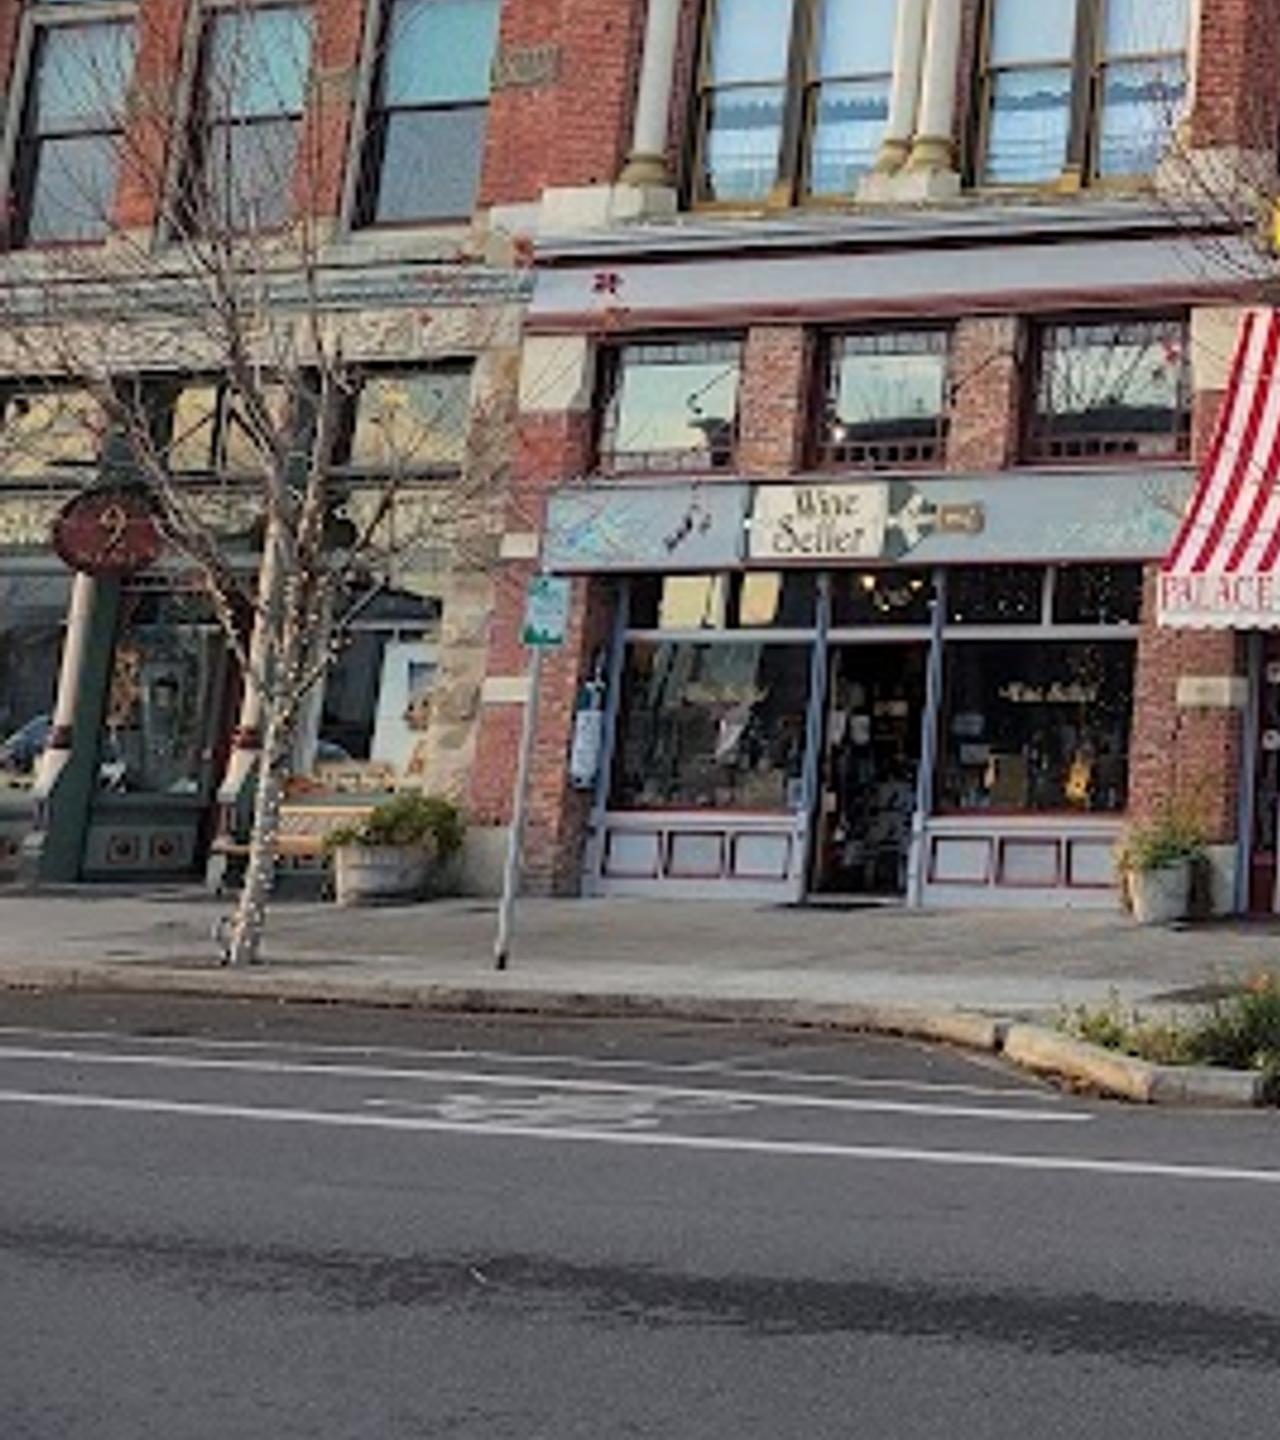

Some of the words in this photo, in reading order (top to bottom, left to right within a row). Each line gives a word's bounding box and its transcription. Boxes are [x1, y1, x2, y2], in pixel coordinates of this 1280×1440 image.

[796, 488, 861, 516] Wine
[772, 514, 866, 554] Seller
[1162, 573, 1274, 610] PALACE
